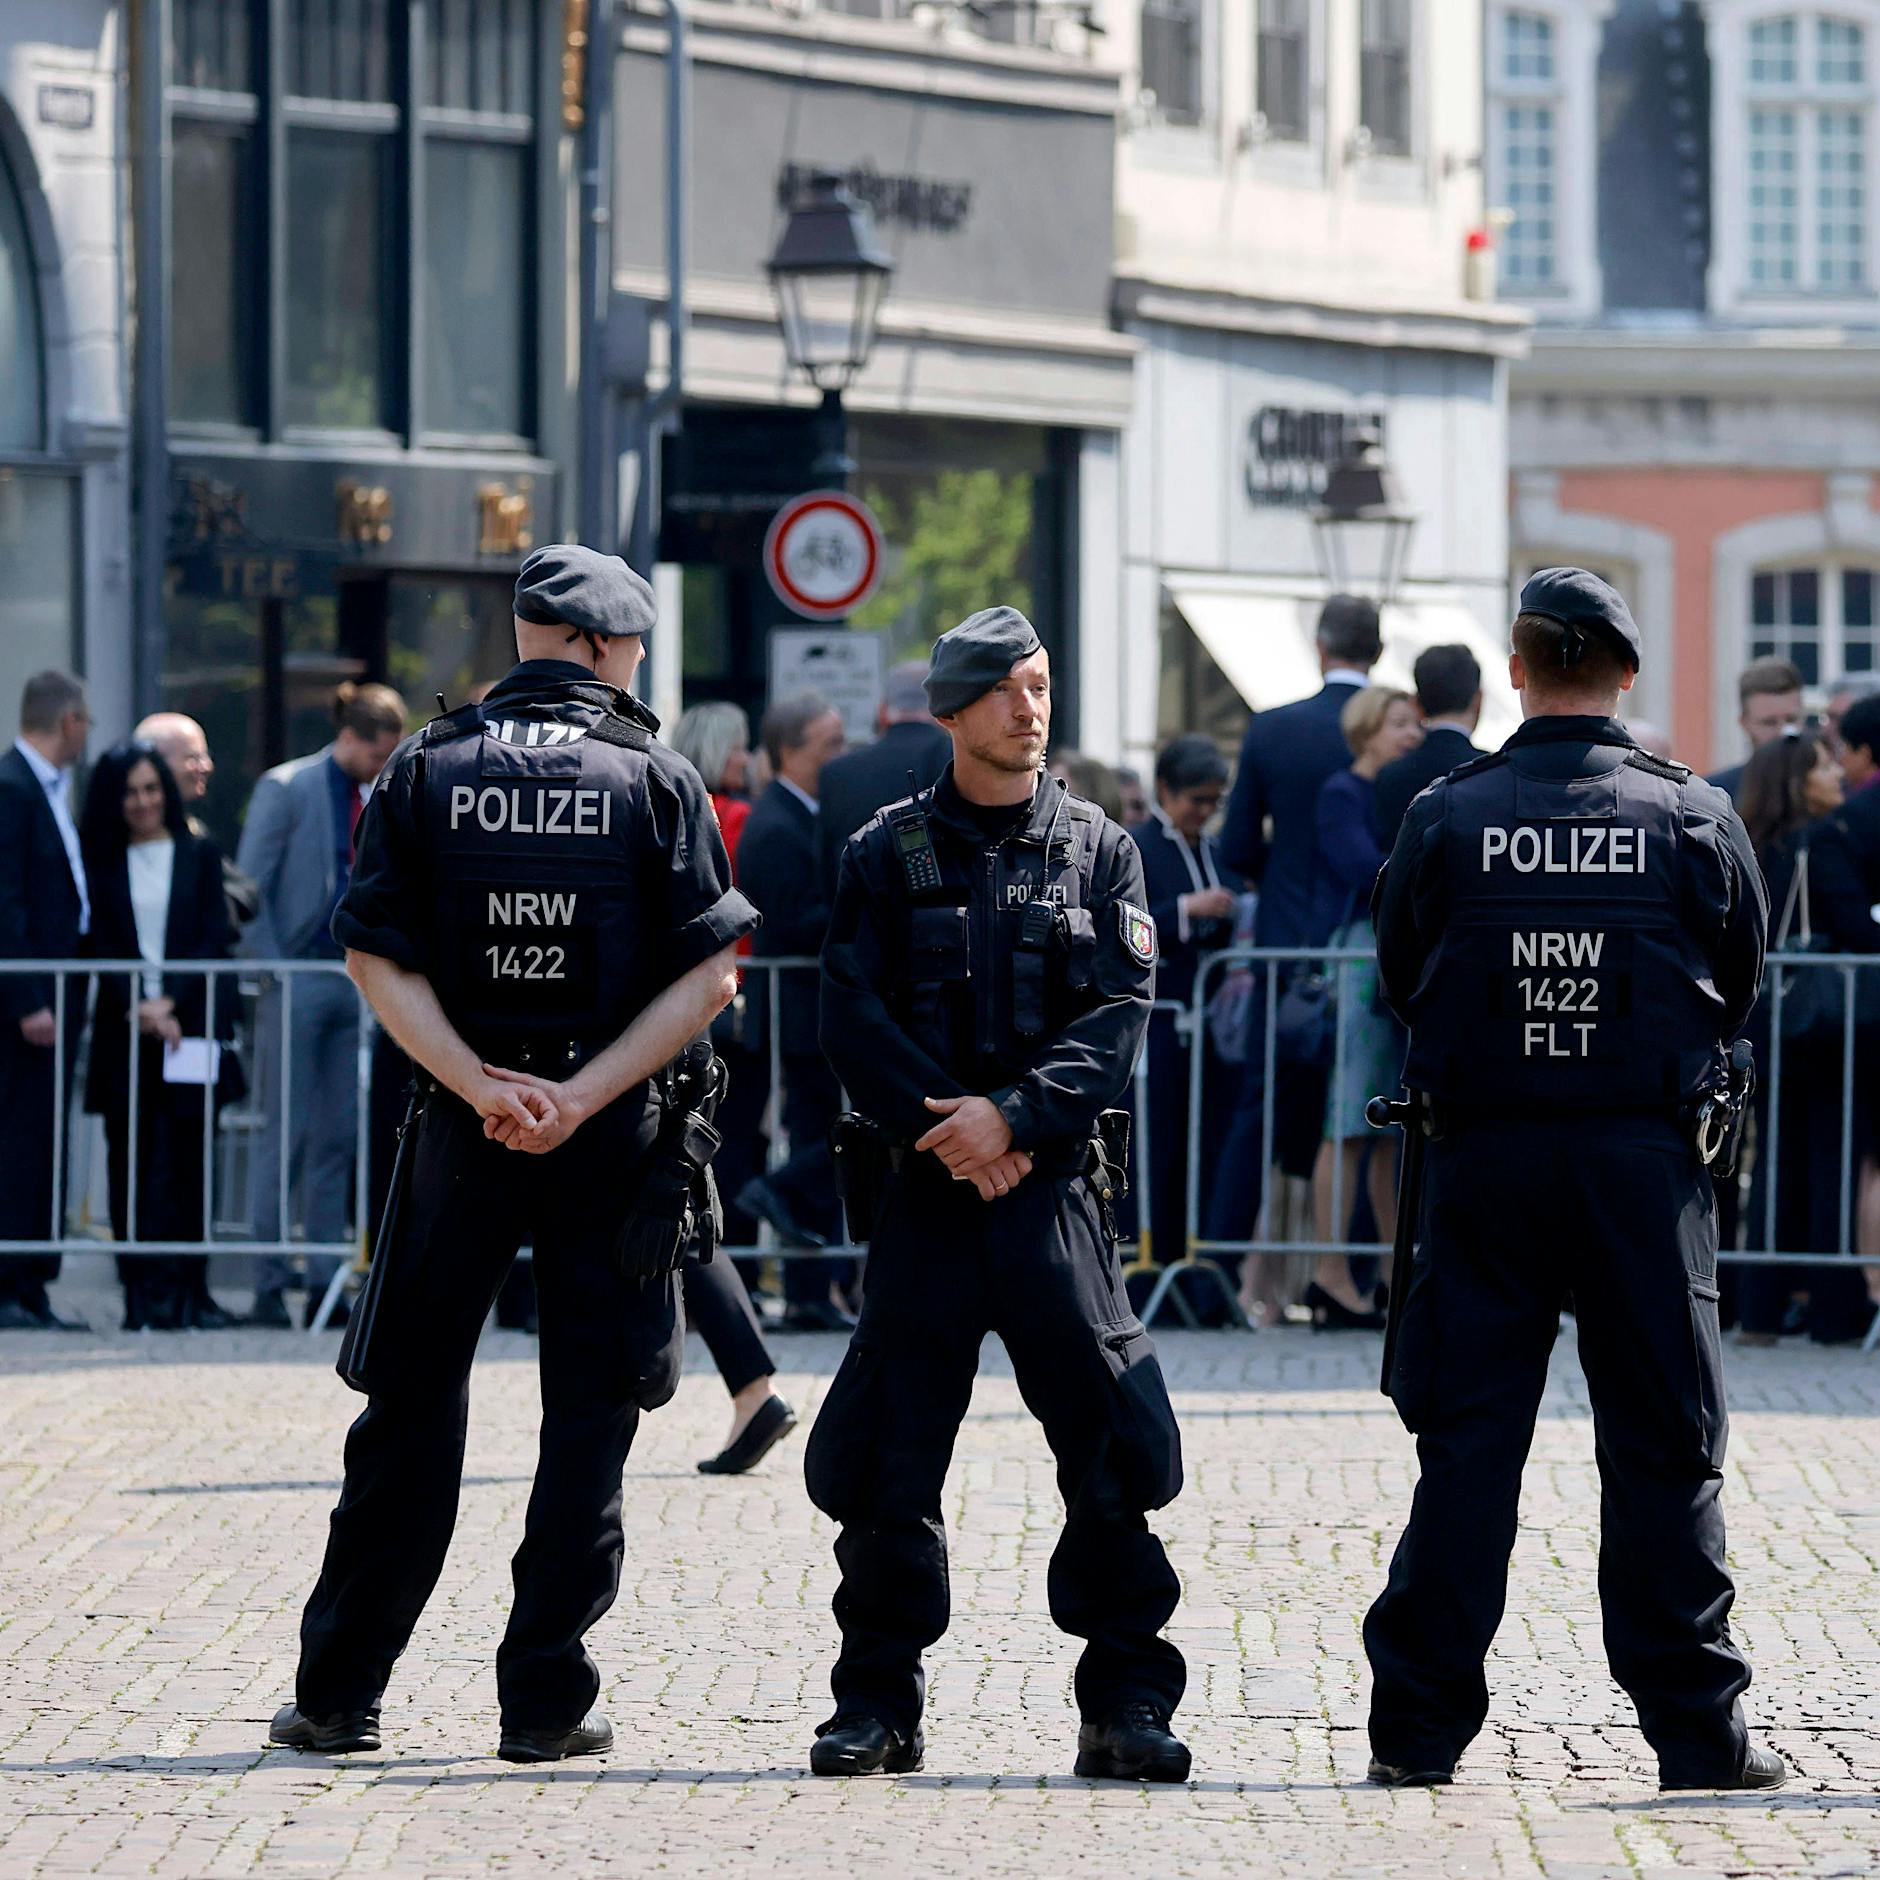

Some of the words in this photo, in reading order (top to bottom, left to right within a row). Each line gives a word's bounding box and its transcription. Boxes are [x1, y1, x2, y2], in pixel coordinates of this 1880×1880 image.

[450, 785, 612, 835] POLIZEI
[1482, 827, 1648, 875] POLIZEI
[487, 892, 578, 926] NRW
[1006, 884, 1068, 905] POZEI
[485, 945, 566, 980] 1422
[1512, 932, 1605, 967] NRW
[1517, 977, 1600, 1012] 1422
[1523, 1022, 1597, 1057] FLT
